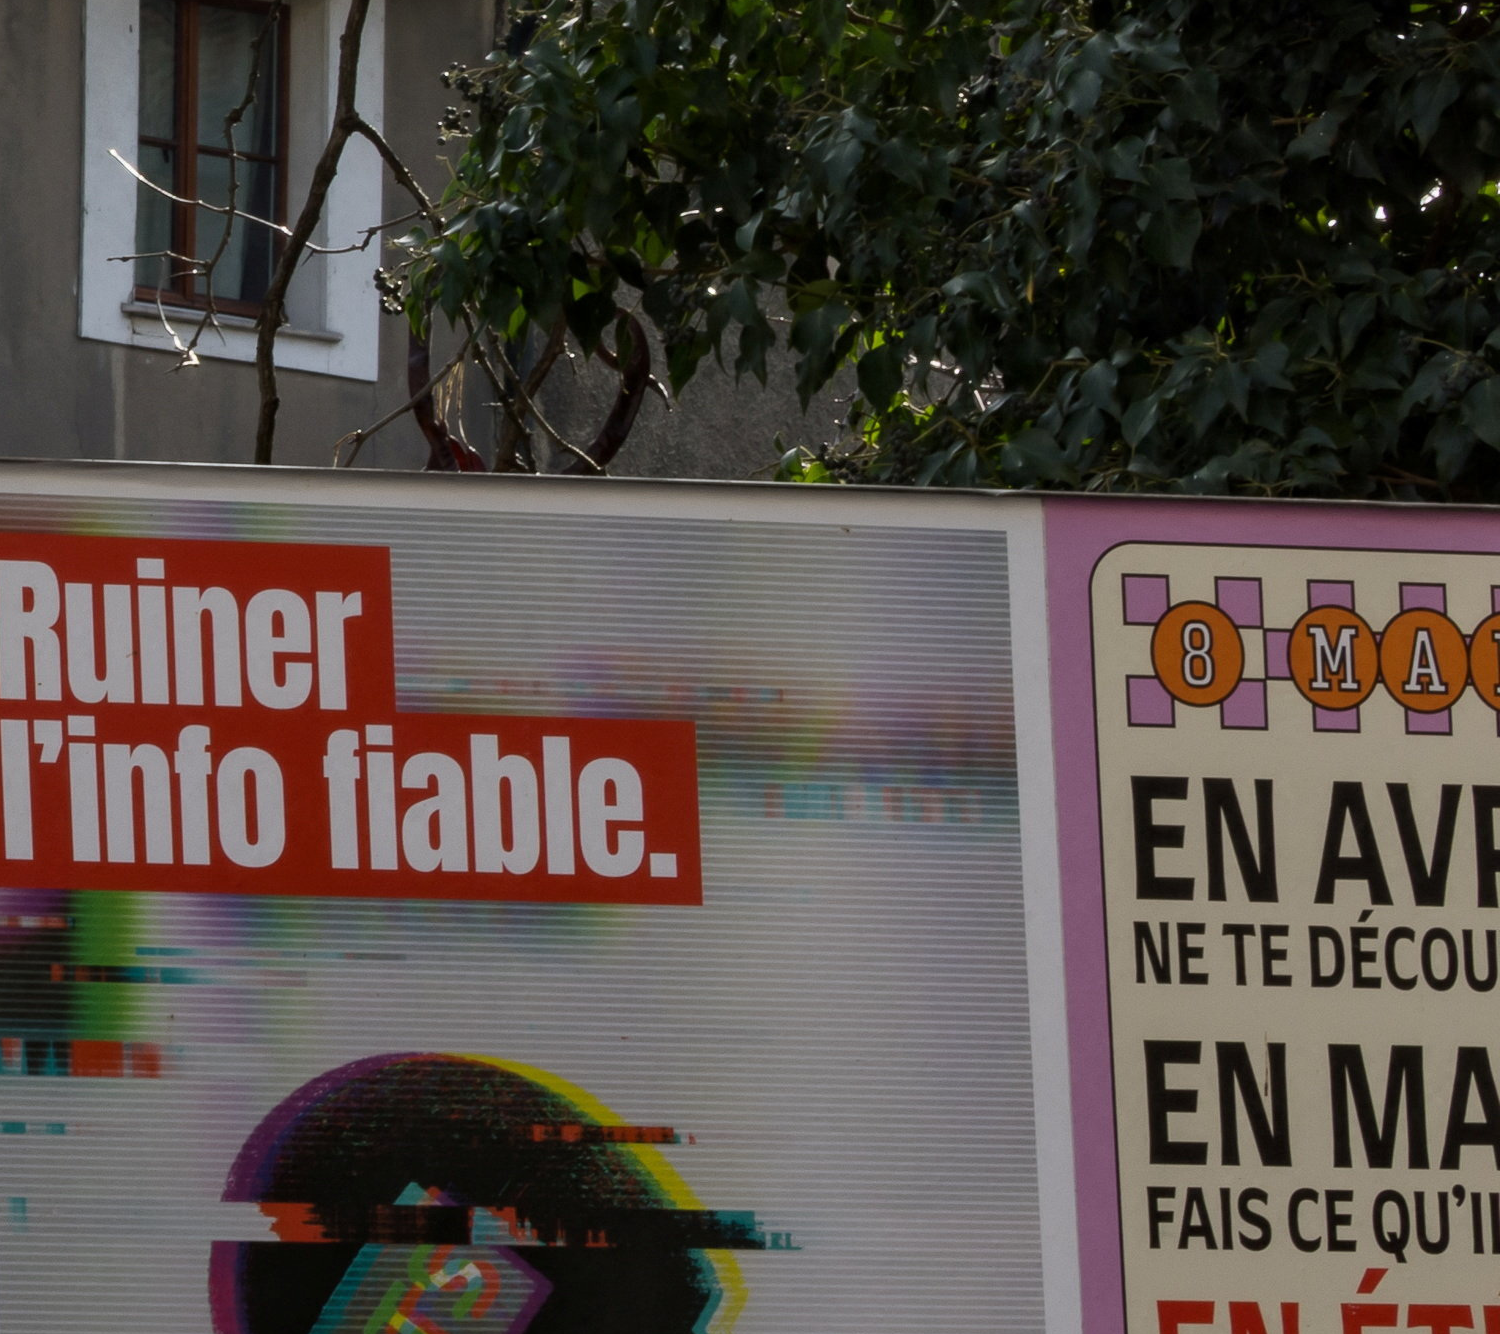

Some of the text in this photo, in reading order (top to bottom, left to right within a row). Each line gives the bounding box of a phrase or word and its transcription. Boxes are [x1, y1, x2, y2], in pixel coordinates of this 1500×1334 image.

[1181, 620, 1500, 698] 8 MA
[0, 715, 678, 879] l'info fiable.
[1130, 775, 1279, 903] EN
[1133, 909, 1500, 993] NE TE DÉCOU
[1143, 1039, 1500, 1171] EN MA
[1146, 1185, 1273, 1252] FAIS
[1287, 1187, 1358, 1254] CE
